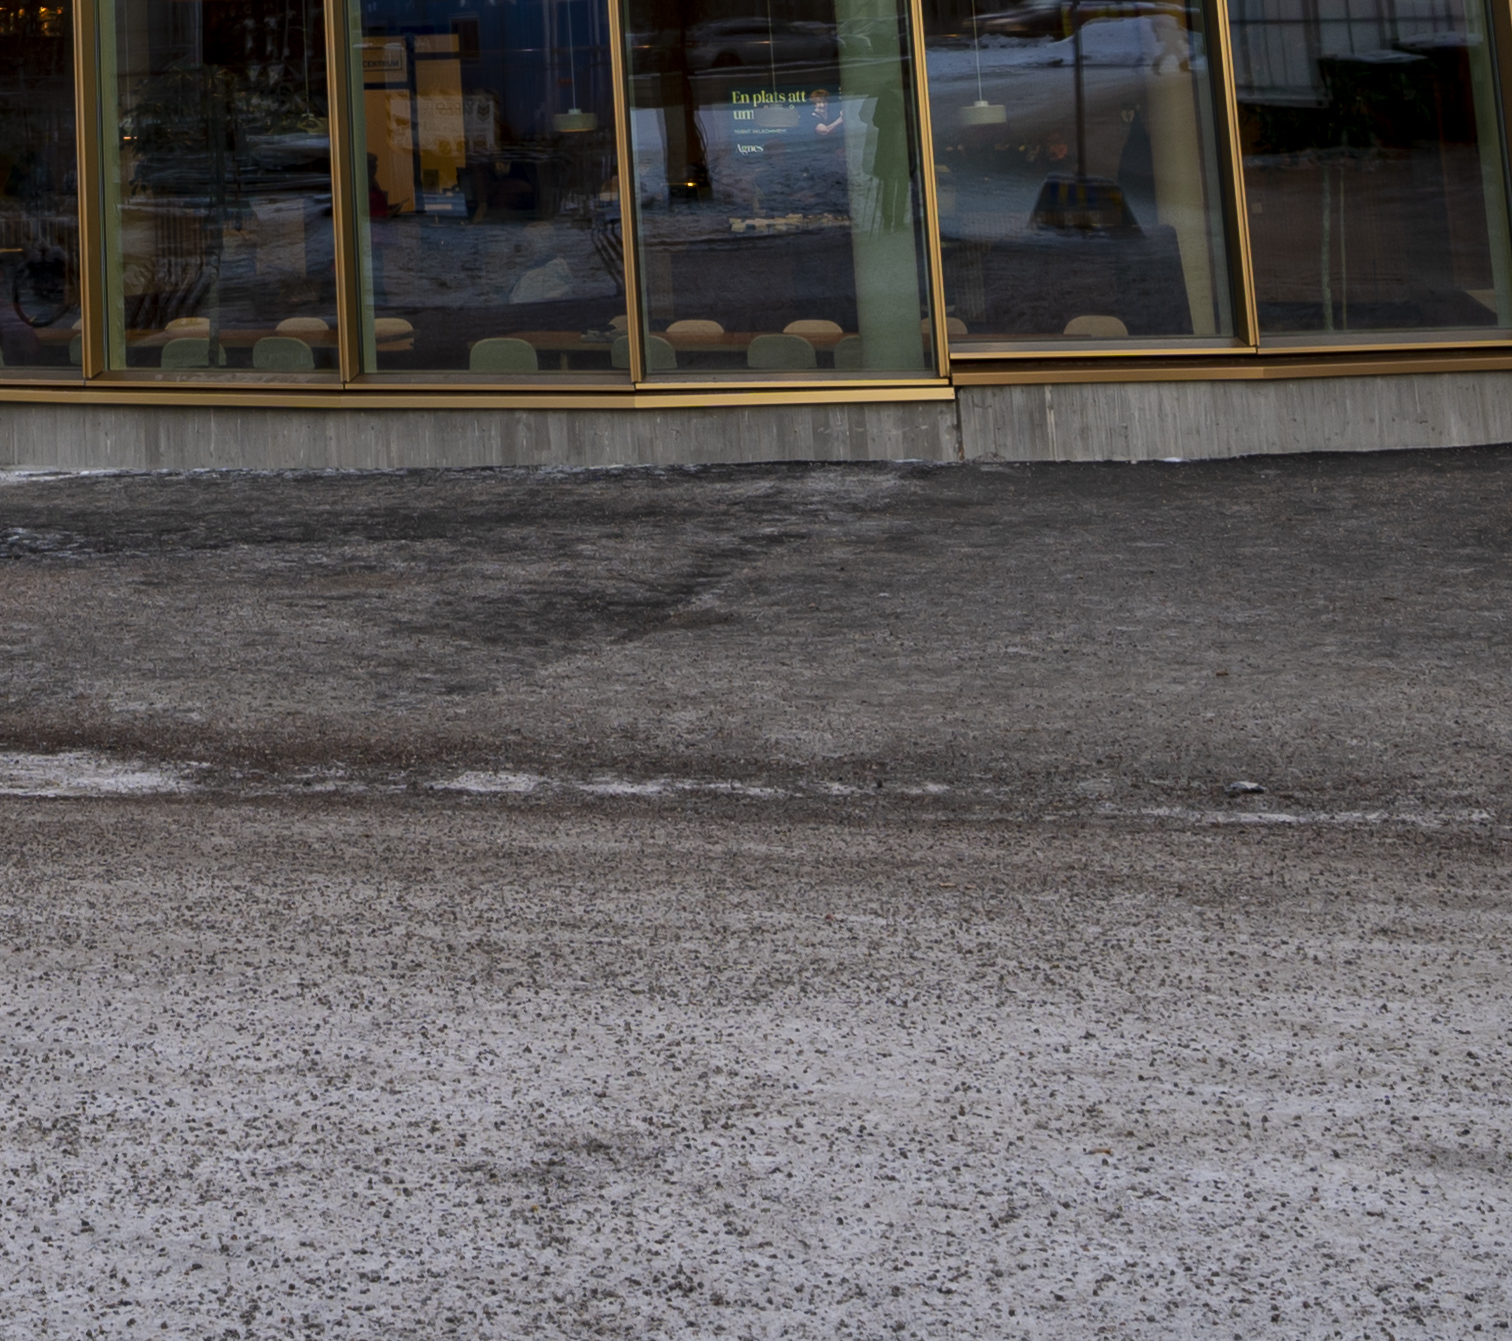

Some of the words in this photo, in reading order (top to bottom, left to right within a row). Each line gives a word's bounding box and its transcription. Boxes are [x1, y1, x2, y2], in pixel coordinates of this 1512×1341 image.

[732, 90, 750, 104] En
[753, 90, 786, 107] plats
[788, 90, 807, 103] att
